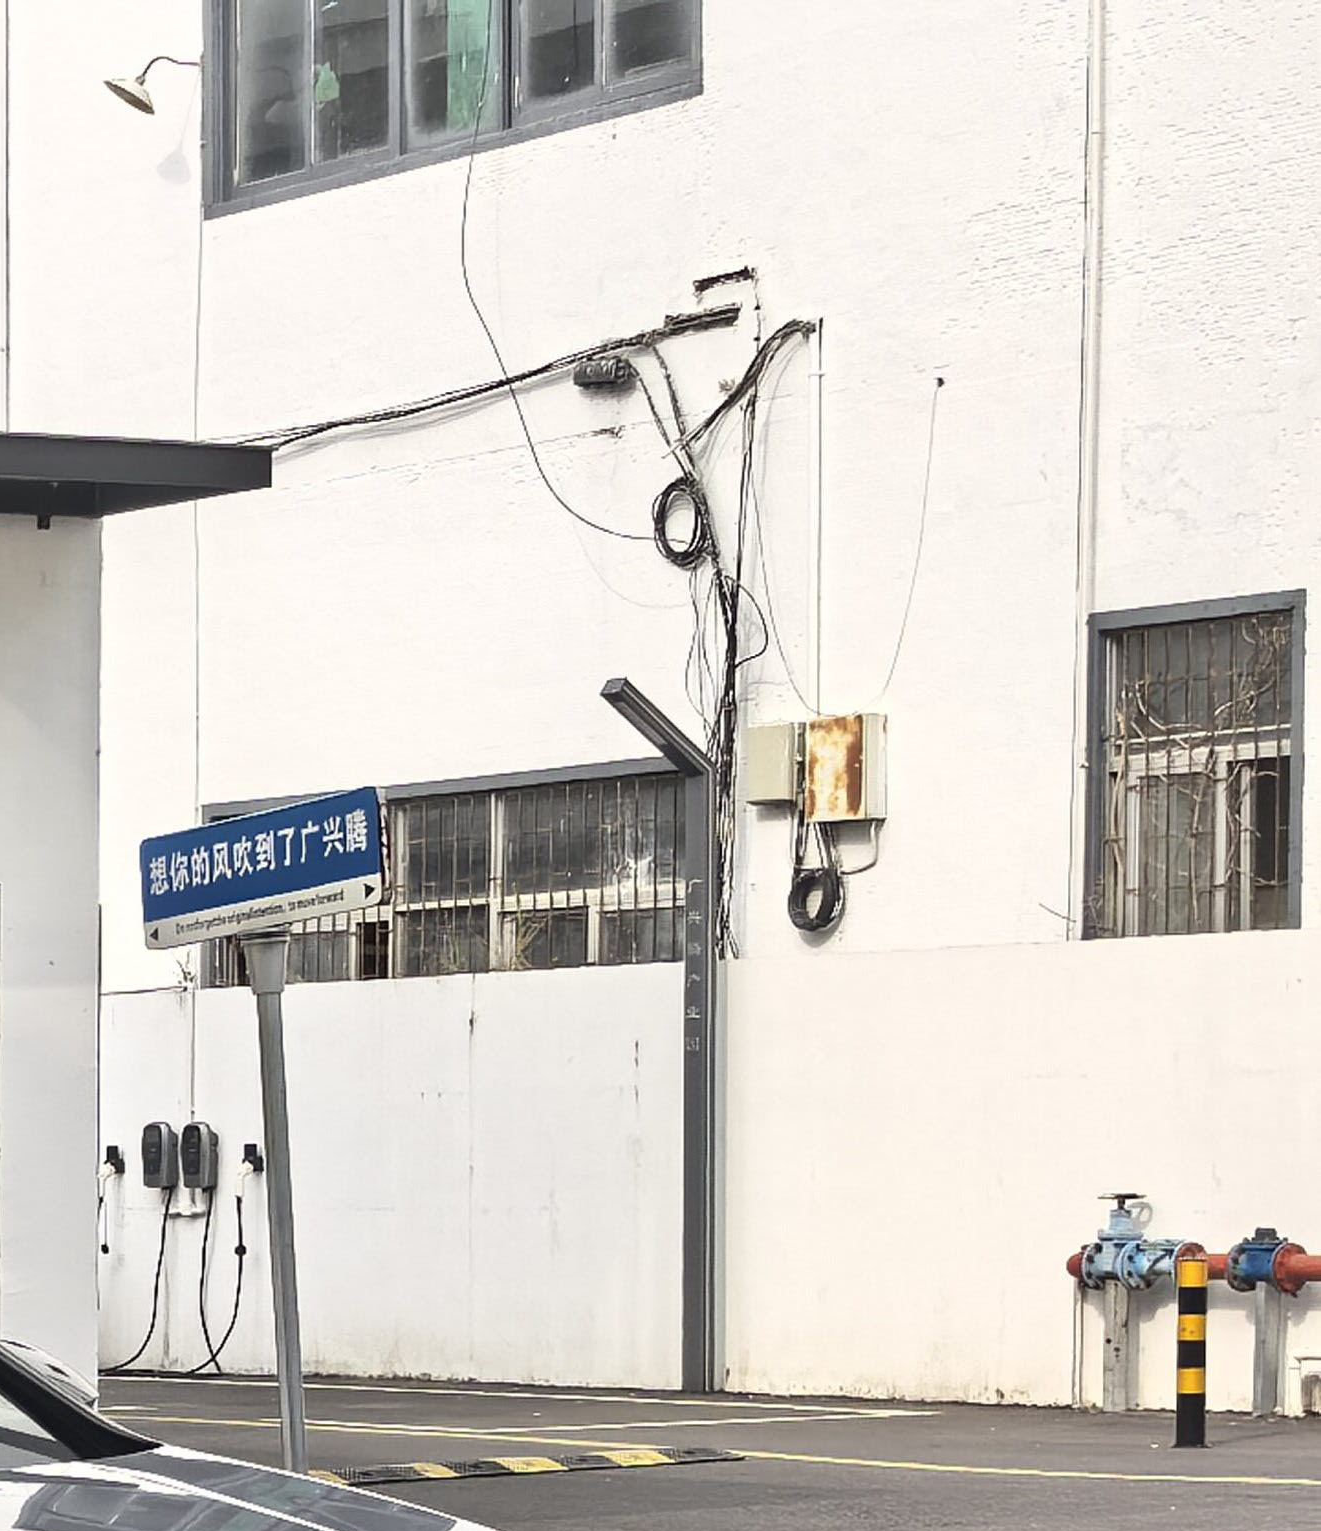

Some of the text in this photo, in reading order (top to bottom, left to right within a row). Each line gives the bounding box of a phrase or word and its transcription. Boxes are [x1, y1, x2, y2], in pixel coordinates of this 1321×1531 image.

[149, 808, 369, 896] 想你的风吹到了广兴腾
